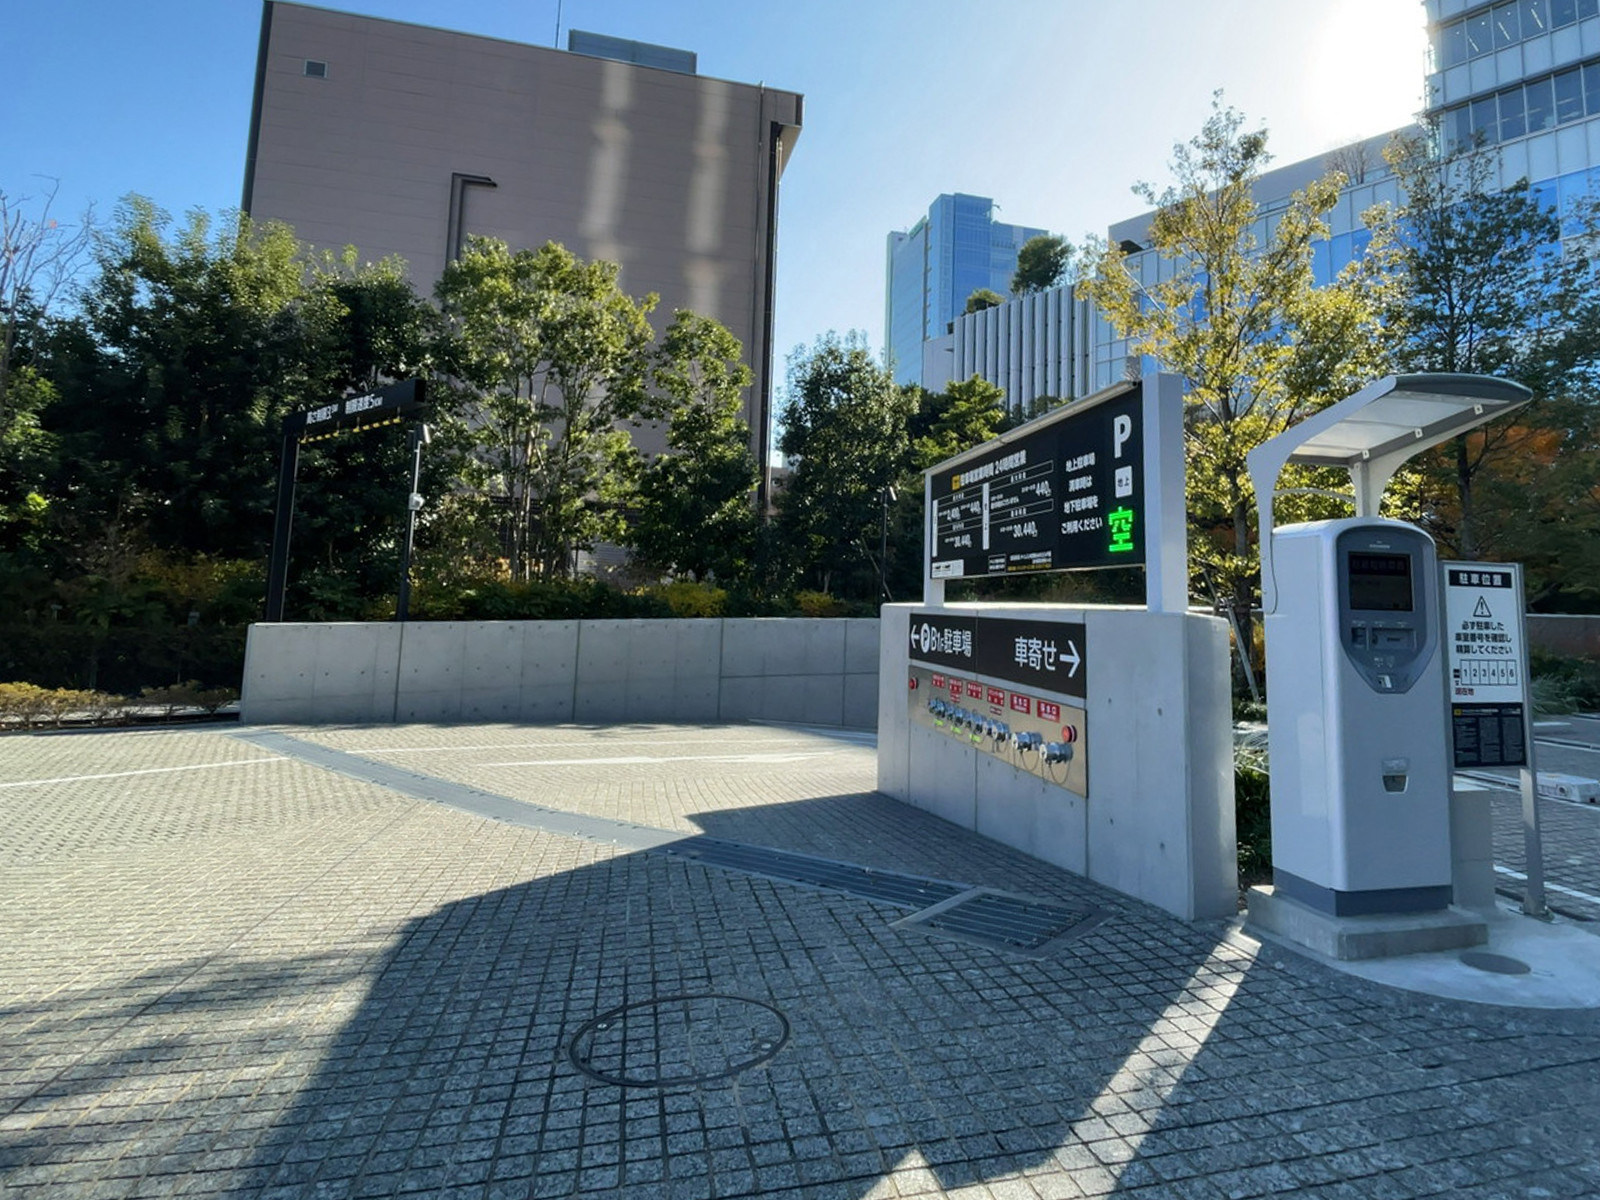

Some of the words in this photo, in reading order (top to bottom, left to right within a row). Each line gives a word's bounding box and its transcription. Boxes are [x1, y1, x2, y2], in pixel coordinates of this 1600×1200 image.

[1113, 414, 1132, 459] P
[1065, 452, 1096, 473] 地上駐車場
[1063, 495, 1099, 514] 地下駐車場を
[1061, 517, 1103, 535] ご利用ください
[1108, 506, 1134, 552] 空
[1459, 572, 1503, 586] 駐車位置
[1461, 620, 1505, 631] 必ず駐車した
[1455, 632, 1512, 643] 車室番号を確認し
[1014, 636, 1057, 671] 車寄せ
[1456, 644, 1513, 655] 精算してください
